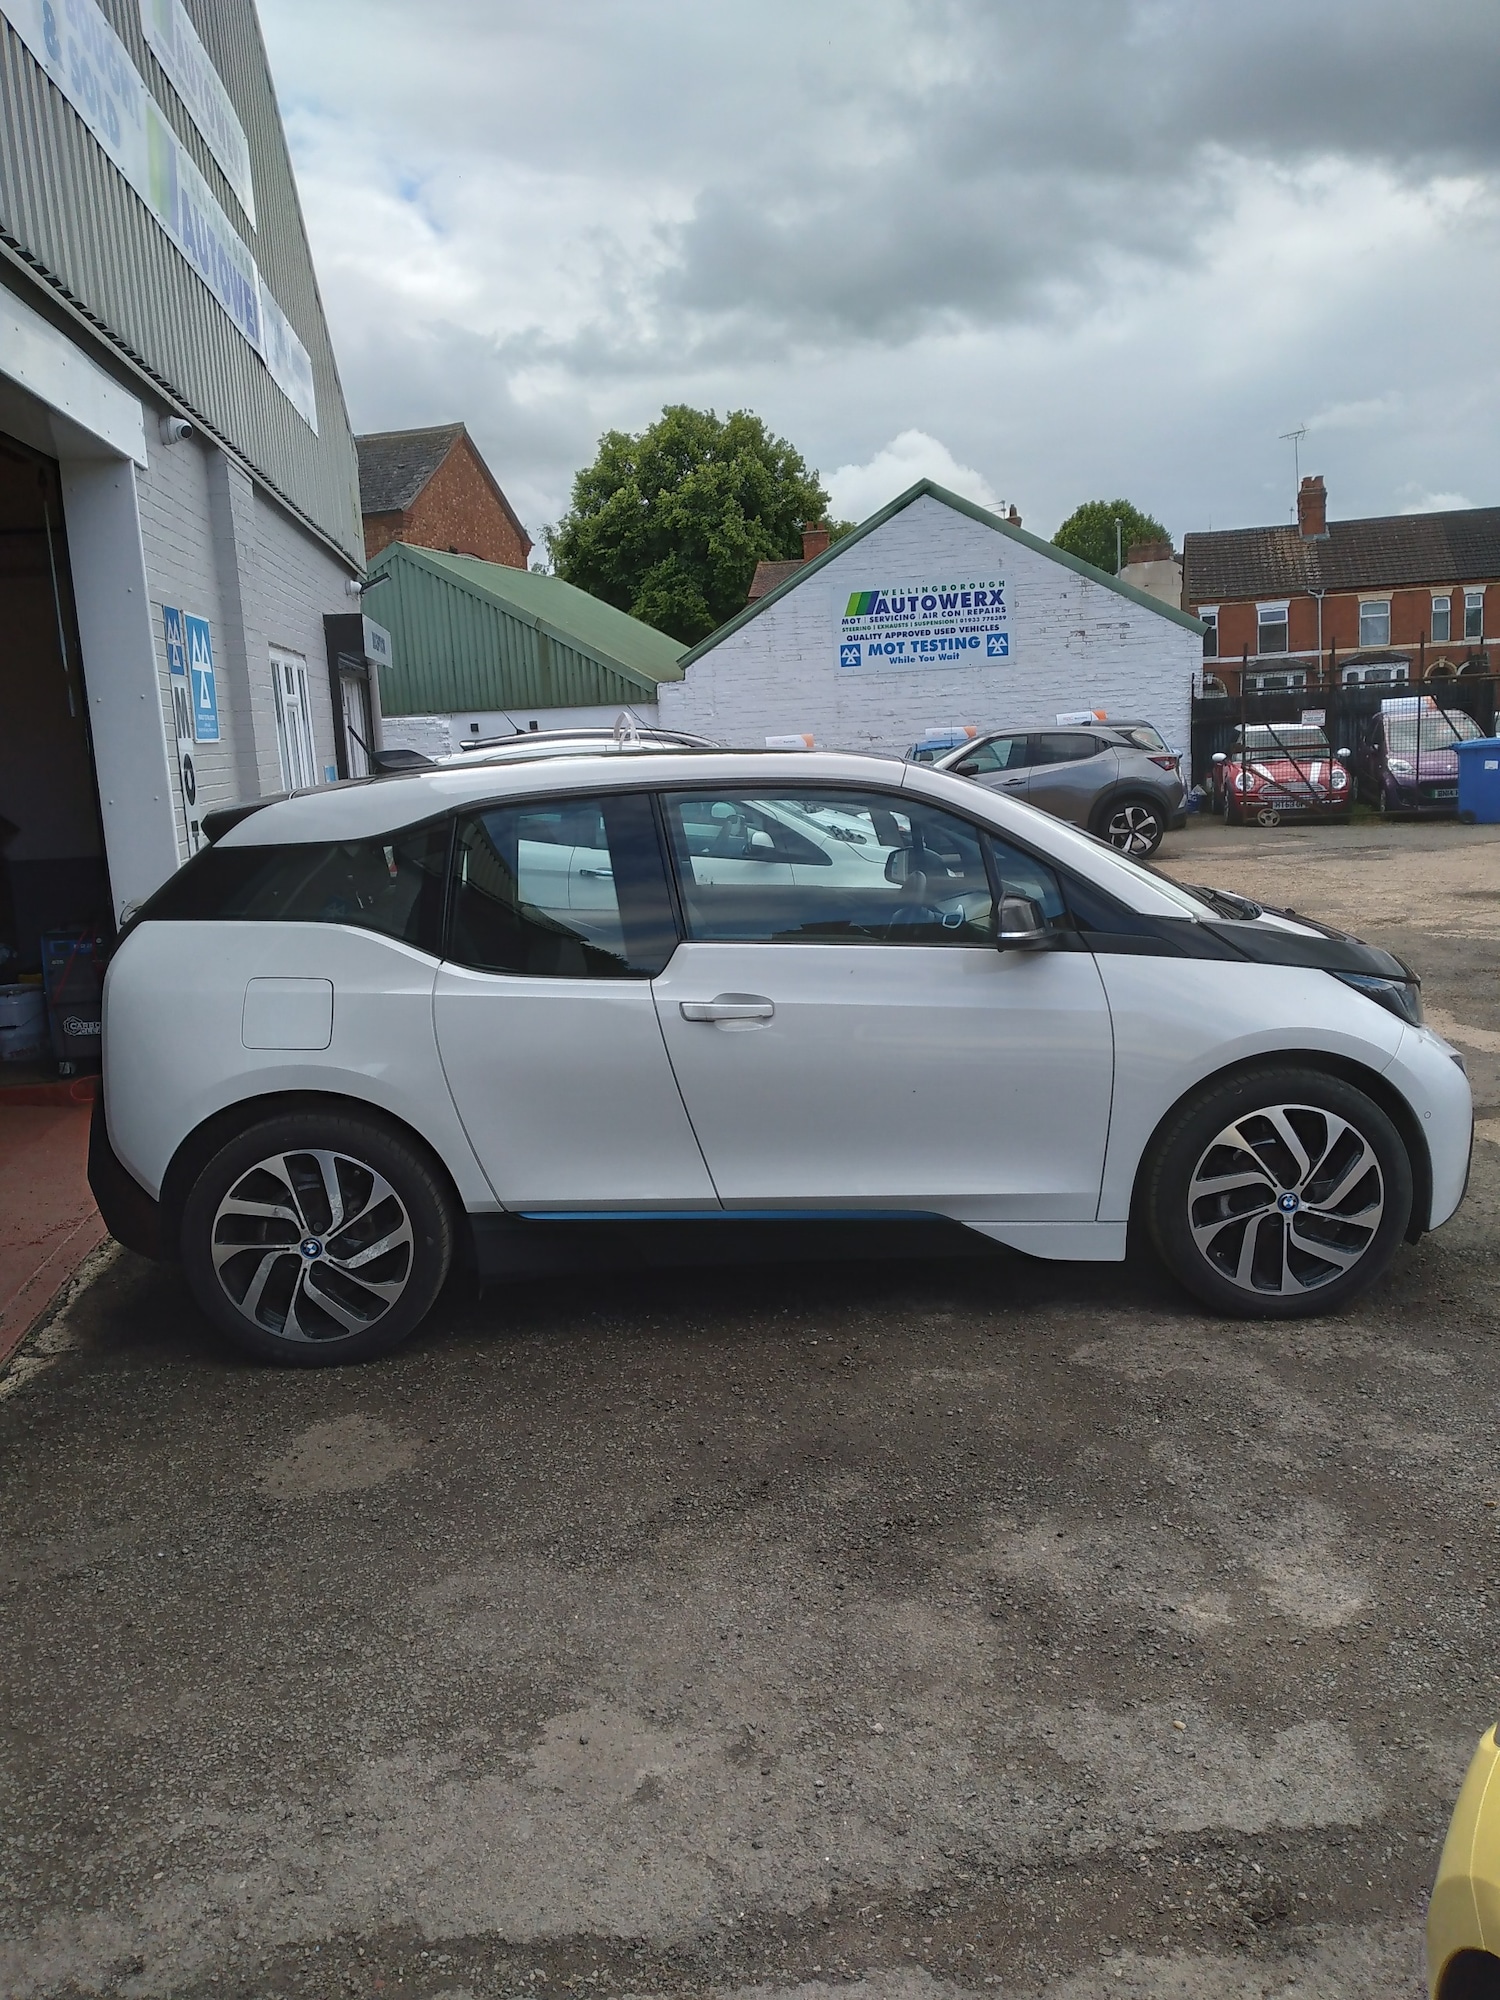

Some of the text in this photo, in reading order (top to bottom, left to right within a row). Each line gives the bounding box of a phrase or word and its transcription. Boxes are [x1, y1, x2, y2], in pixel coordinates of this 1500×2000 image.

[67, 35, 121, 150] SOLD
[880, 580, 1006, 597] WELLINGBOROUGH
[875, 589, 1006, 615] AUTOWERX
[841, 606, 1007, 625] MOT SERVICING AIR CON REPAIRS
[842, 624, 872, 633] STEERING
[877, 621, 908, 630] EXHAUSTS
[914, 618, 954, 628] SUSPENSION
[960, 617, 980, 625] 01933
[846, 624, 1001, 642] QUALITY APPROVED USED VEHICLES
[868, 635, 981, 656] MOT TESTING
[889, 651, 960, 665] While You Wait
[69, 1022, 101, 1030] CARBO
